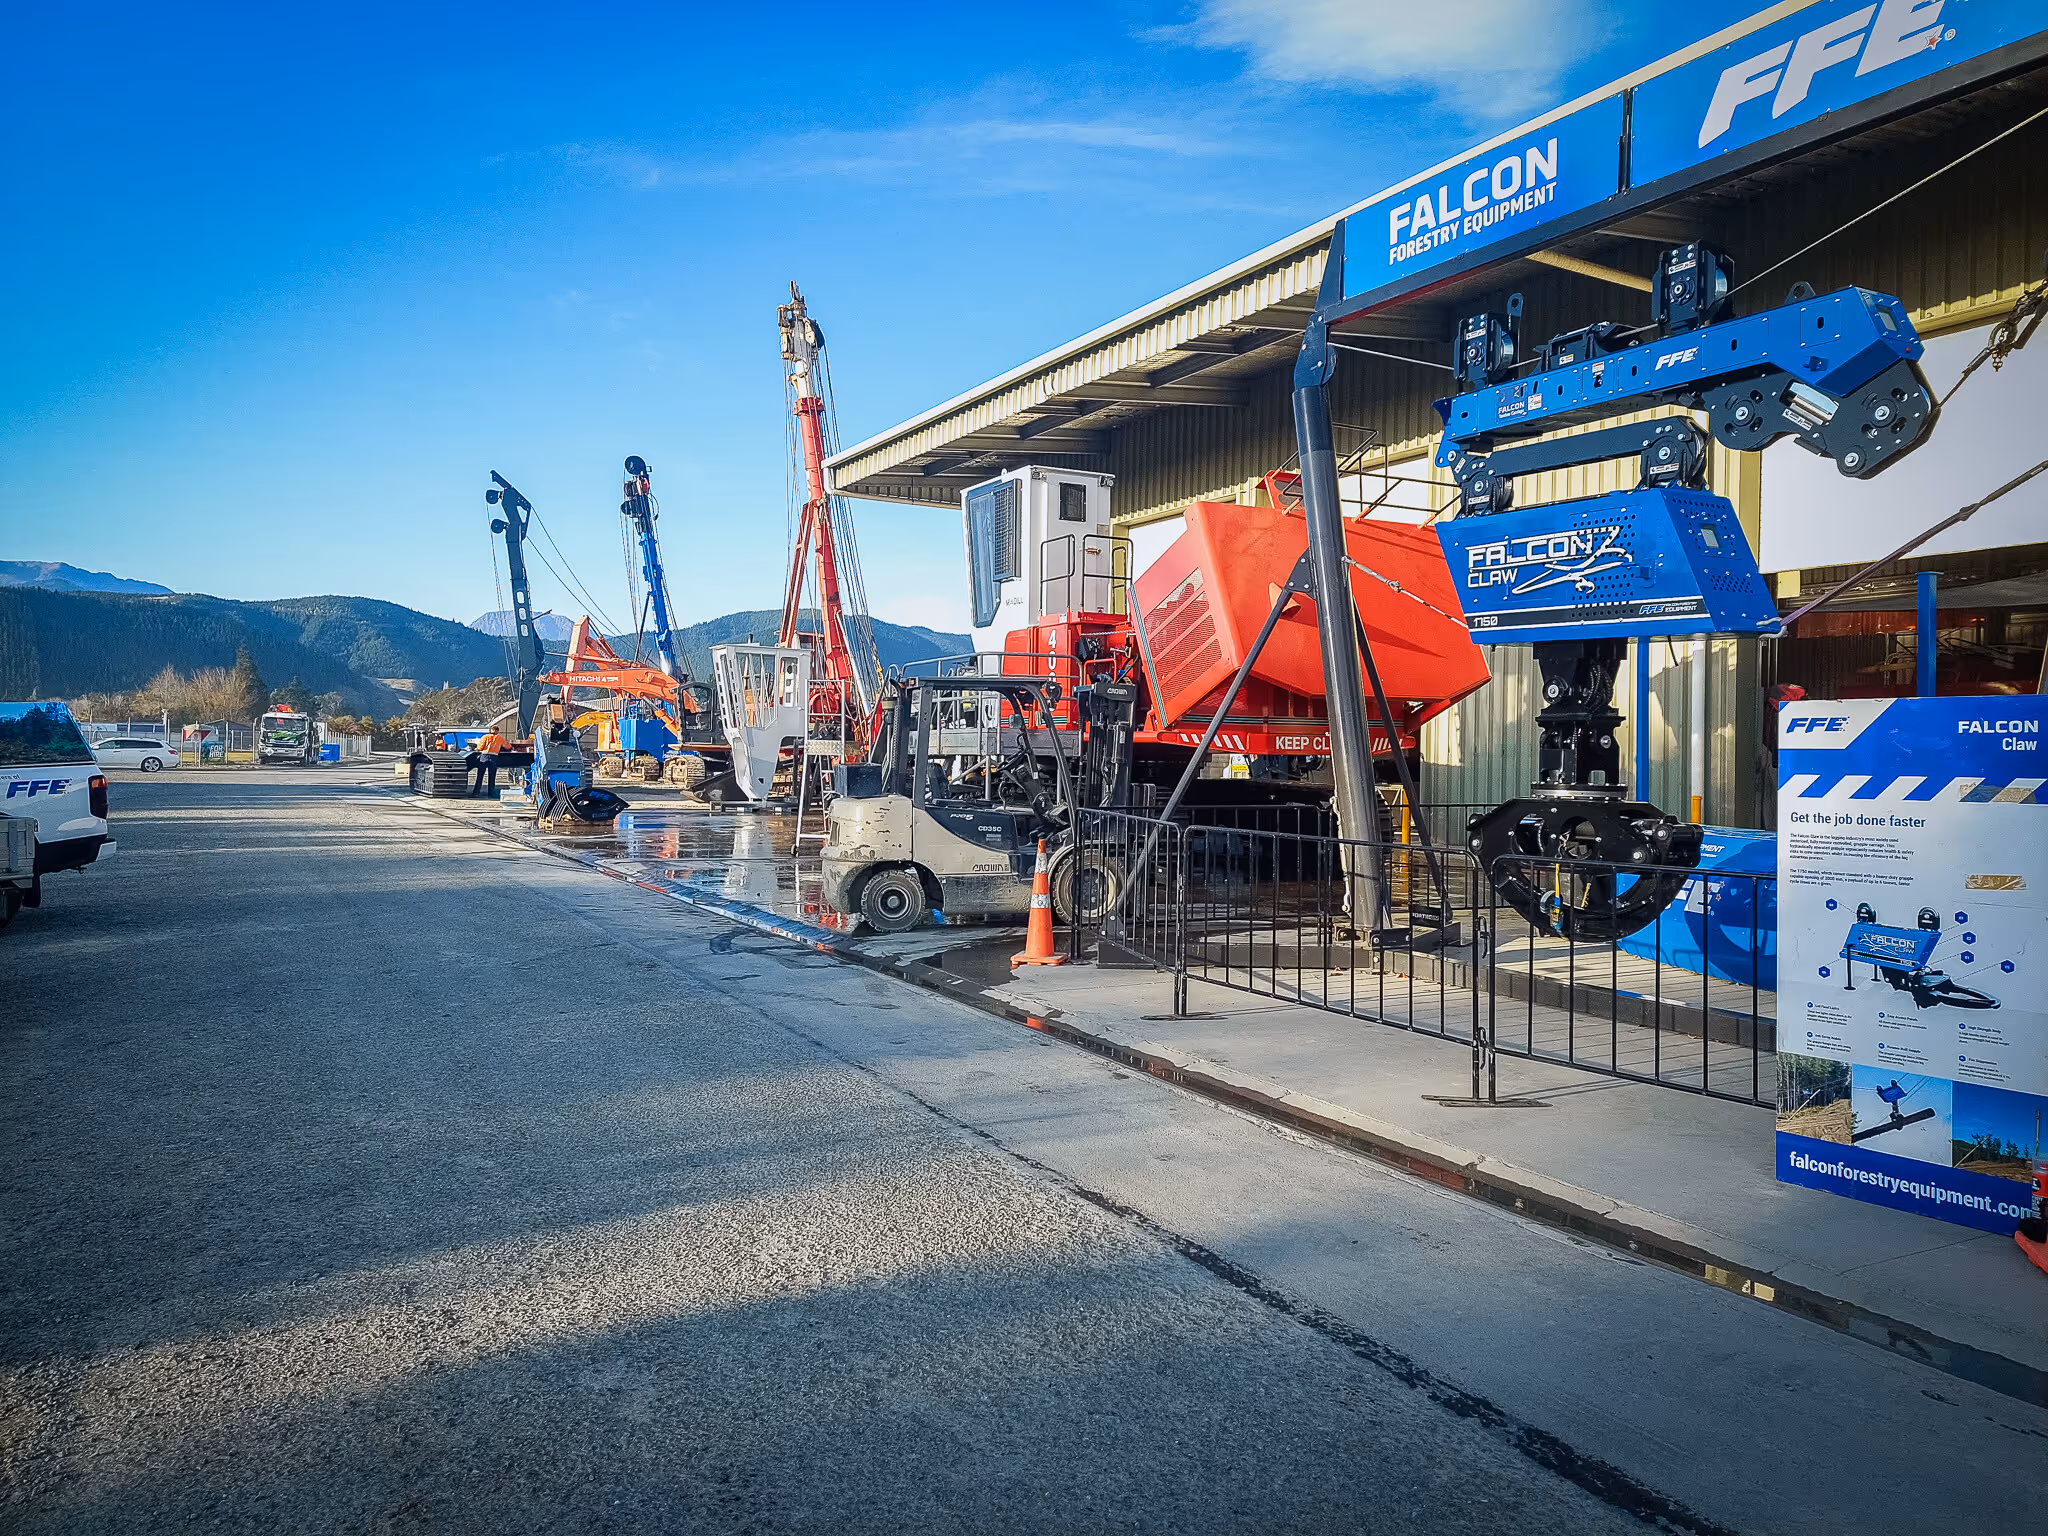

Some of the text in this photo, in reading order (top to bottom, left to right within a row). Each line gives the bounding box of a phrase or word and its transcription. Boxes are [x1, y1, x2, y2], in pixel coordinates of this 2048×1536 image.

[1698, 0, 1945, 149] FFE
[1389, 137, 1558, 246] FALCON
[1389, 181, 1558, 266] FORESTRY EQUIPMENT
[1655, 347, 1697, 371] FFE
[1498, 401, 1525, 414] FALCON
[1468, 533, 1594, 569] FALCON
[1467, 568, 1519, 588] CLAW
[1639, 603, 1665, 614] FFE
[1786, 717, 1847, 734] FFE
[1958, 720, 2039, 734] FALCON
[1275, 736, 1310, 750] KEEP
[2002, 737, 2038, 751] Claw
[6, 779, 71, 800] FFE
[1790, 811, 1926, 828] Get the job done faster
[1871, 935, 1917, 949] FALCON
